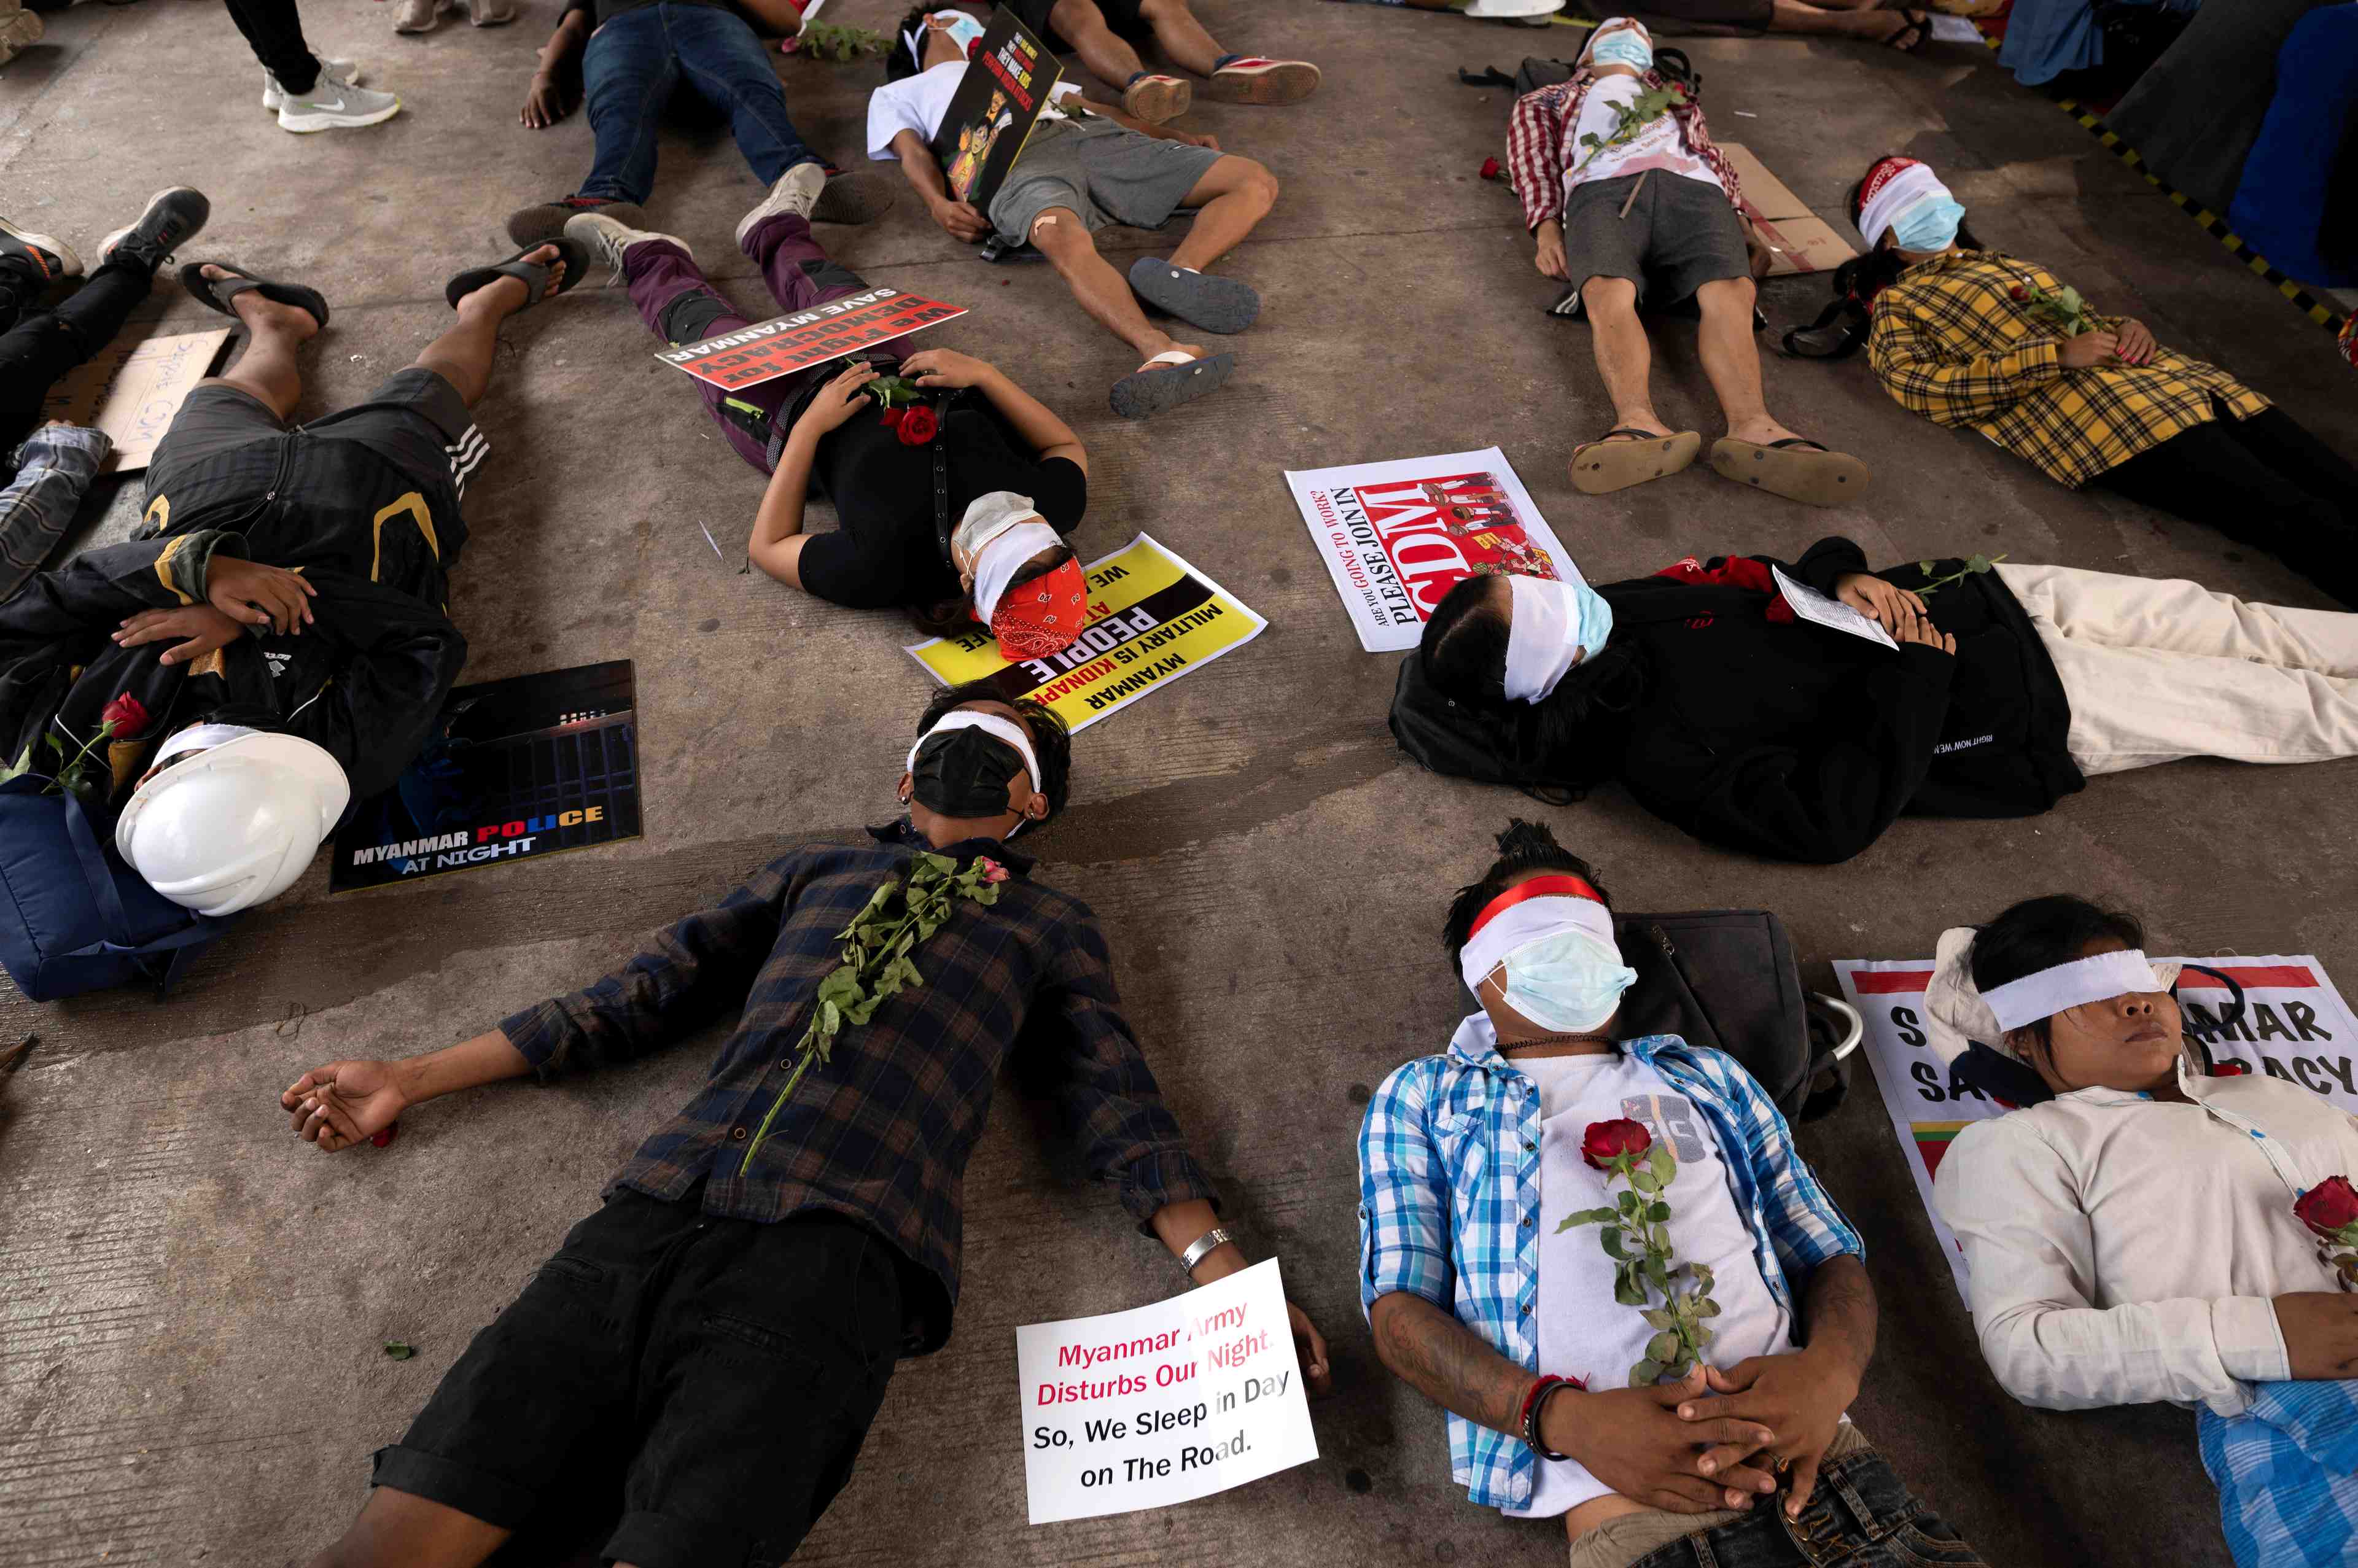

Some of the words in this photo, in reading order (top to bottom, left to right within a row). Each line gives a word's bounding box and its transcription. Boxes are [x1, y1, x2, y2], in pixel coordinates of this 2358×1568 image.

[997, 47, 1012, 67] THEY
[1007, 58, 1024, 80] MAKE
[1018, 70, 1032, 89] KIDS
[820, 288, 897, 315] SAVE
[889, 307, 956, 327] We
[666, 312, 821, 361] MYANMAR
[697, 297, 929, 375] DEMOCRACY
[784, 327, 892, 363] Fight
[723, 362, 783, 383] for
[1310, 490, 1339, 529] WORK?
[1330, 486, 1356, 506] IN
[1331, 532, 1350, 549] TO
[1342, 509, 1379, 548] JOIN
[1089, 565, 1130, 588] WE
[1339, 550, 1369, 589] GOING
[1363, 551, 1418, 625] PLEASE
[1361, 589, 1379, 607] YOU
[1371, 608, 1390, 627] ARE
[1019, 606, 1159, 683] PEOPLE
[1137, 603, 1224, 654] MILITARY
[1113, 646, 1140, 664] IS
[1083, 653, 1187, 710] MYANMAR
[1940, 743, 1953, 753] WE
[1955, 739, 1972, 750] NOW
[1972, 734, 1993, 745] RIGHT
[353, 831, 469, 866] MYANMAR
[477, 805, 604, 844] POLICE
[401, 857, 430, 875] AT
[437, 836, 536, 868] NIGHT
[1910, 1061, 1987, 1102] SA
[1058, 1328, 1181, 1370] Myanmar
[1187, 1302, 1248, 1341] Army
[1037, 1373, 1147, 1407] Disturbs
[1156, 1360, 1199, 1388] Our
[1033, 1426, 1075, 1450] So,
[1084, 1418, 1127, 1443] We
[1135, 1400, 1208, 1435] Sleep
[1216, 1390, 1236, 1415] in
[1244, 1370, 1290, 1404] Day
[1080, 1466, 1114, 1488] on
[1123, 1456, 1171, 1483] The
[1181, 1429, 1252, 1472] Road.
